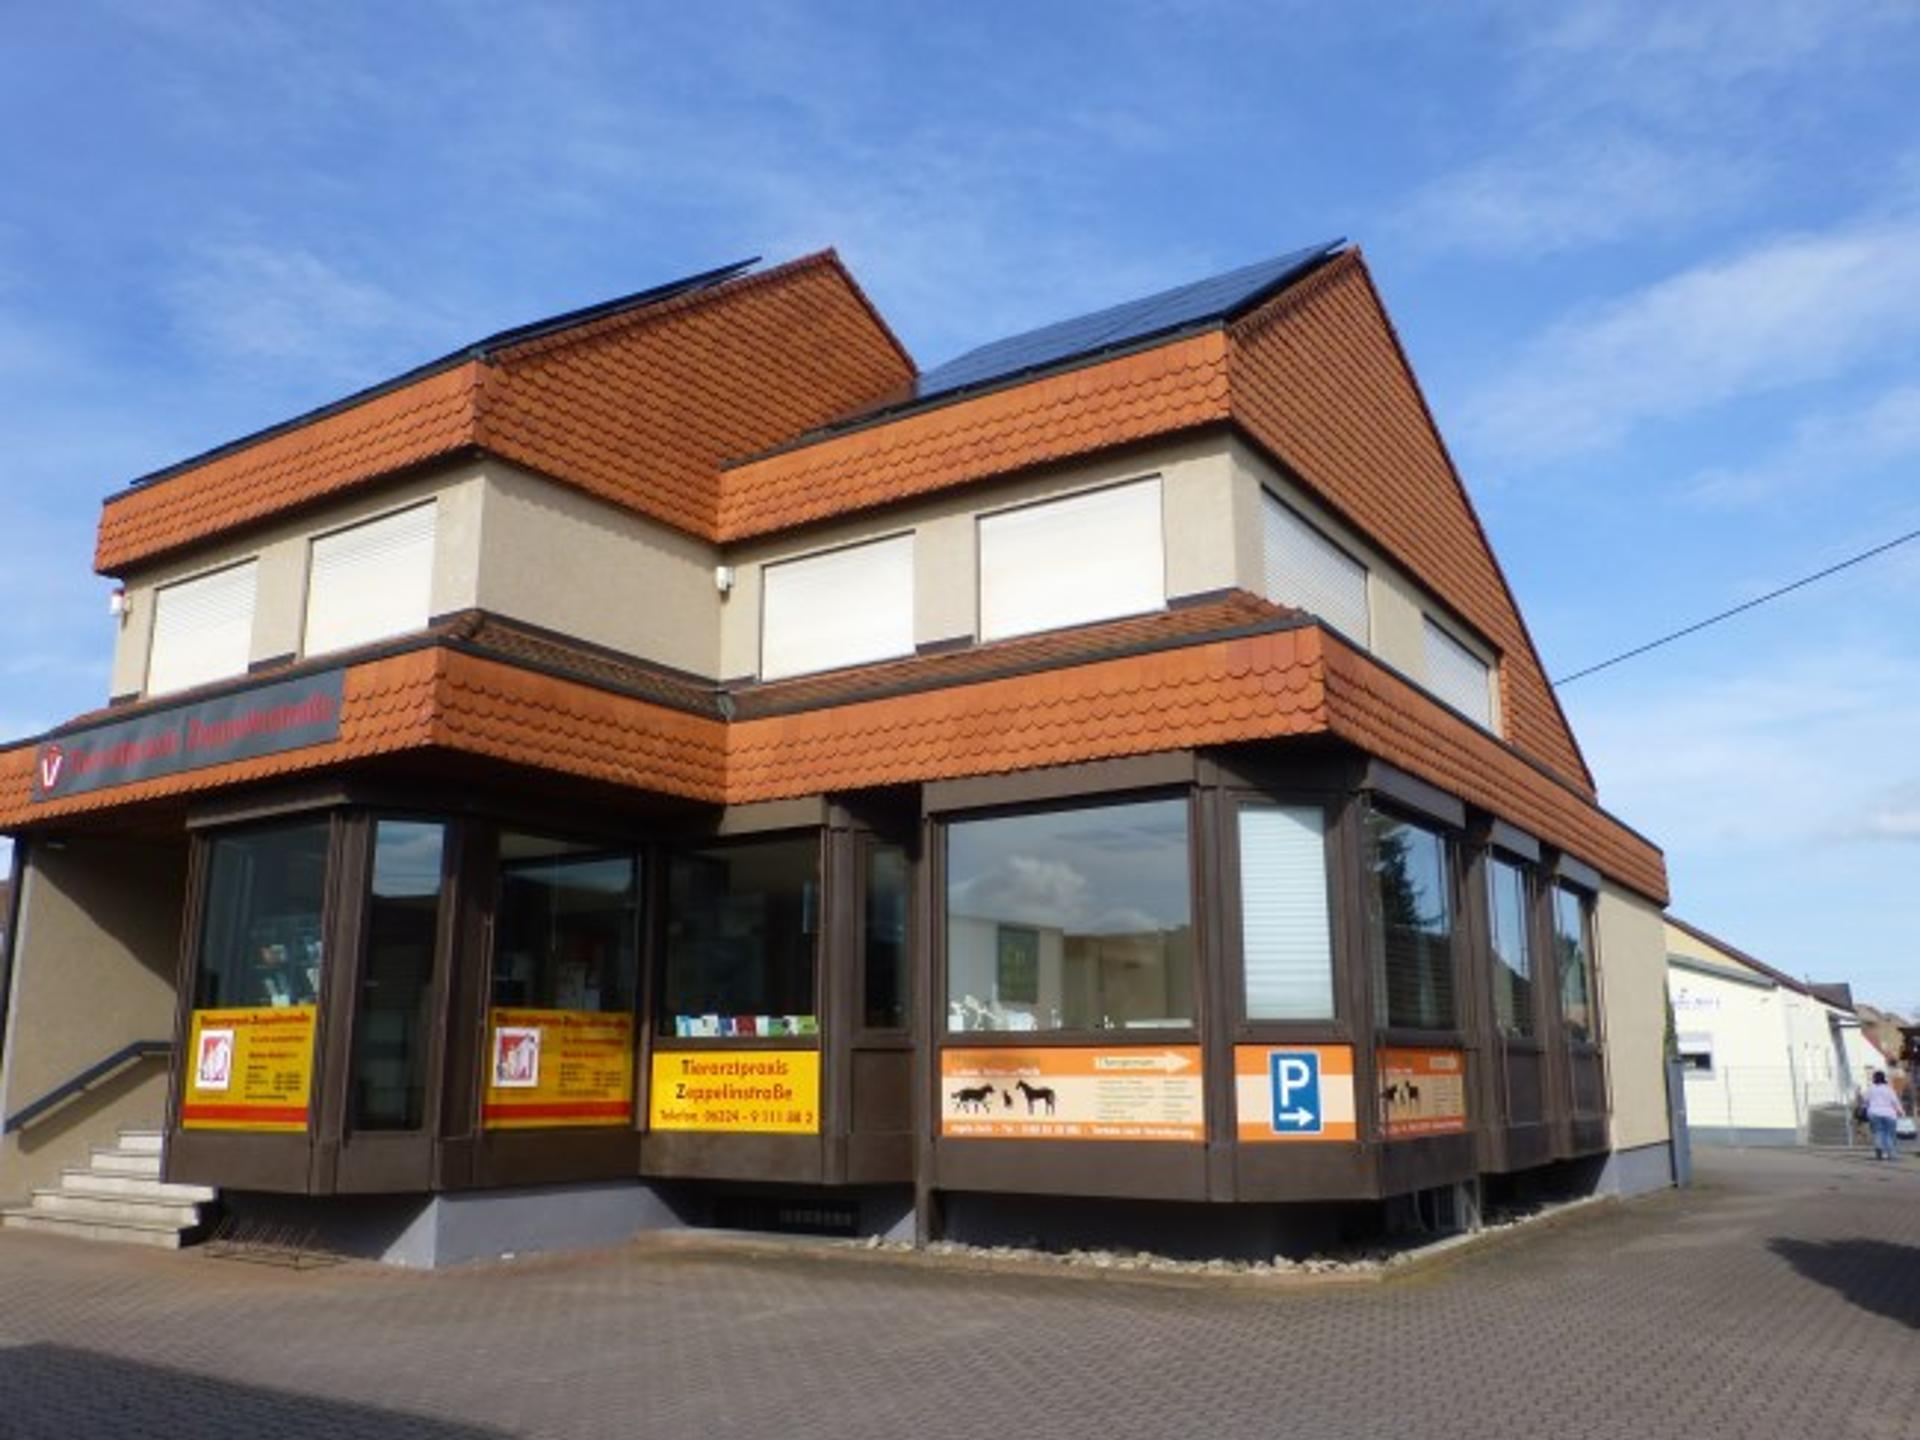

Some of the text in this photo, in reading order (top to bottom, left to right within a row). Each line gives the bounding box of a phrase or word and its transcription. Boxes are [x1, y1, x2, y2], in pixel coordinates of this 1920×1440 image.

[681, 1059, 789, 1079] Tierarztpraxis
[676, 1083, 793, 1104] Zeppelinstraße
[1278, 1059, 1310, 1107] P
